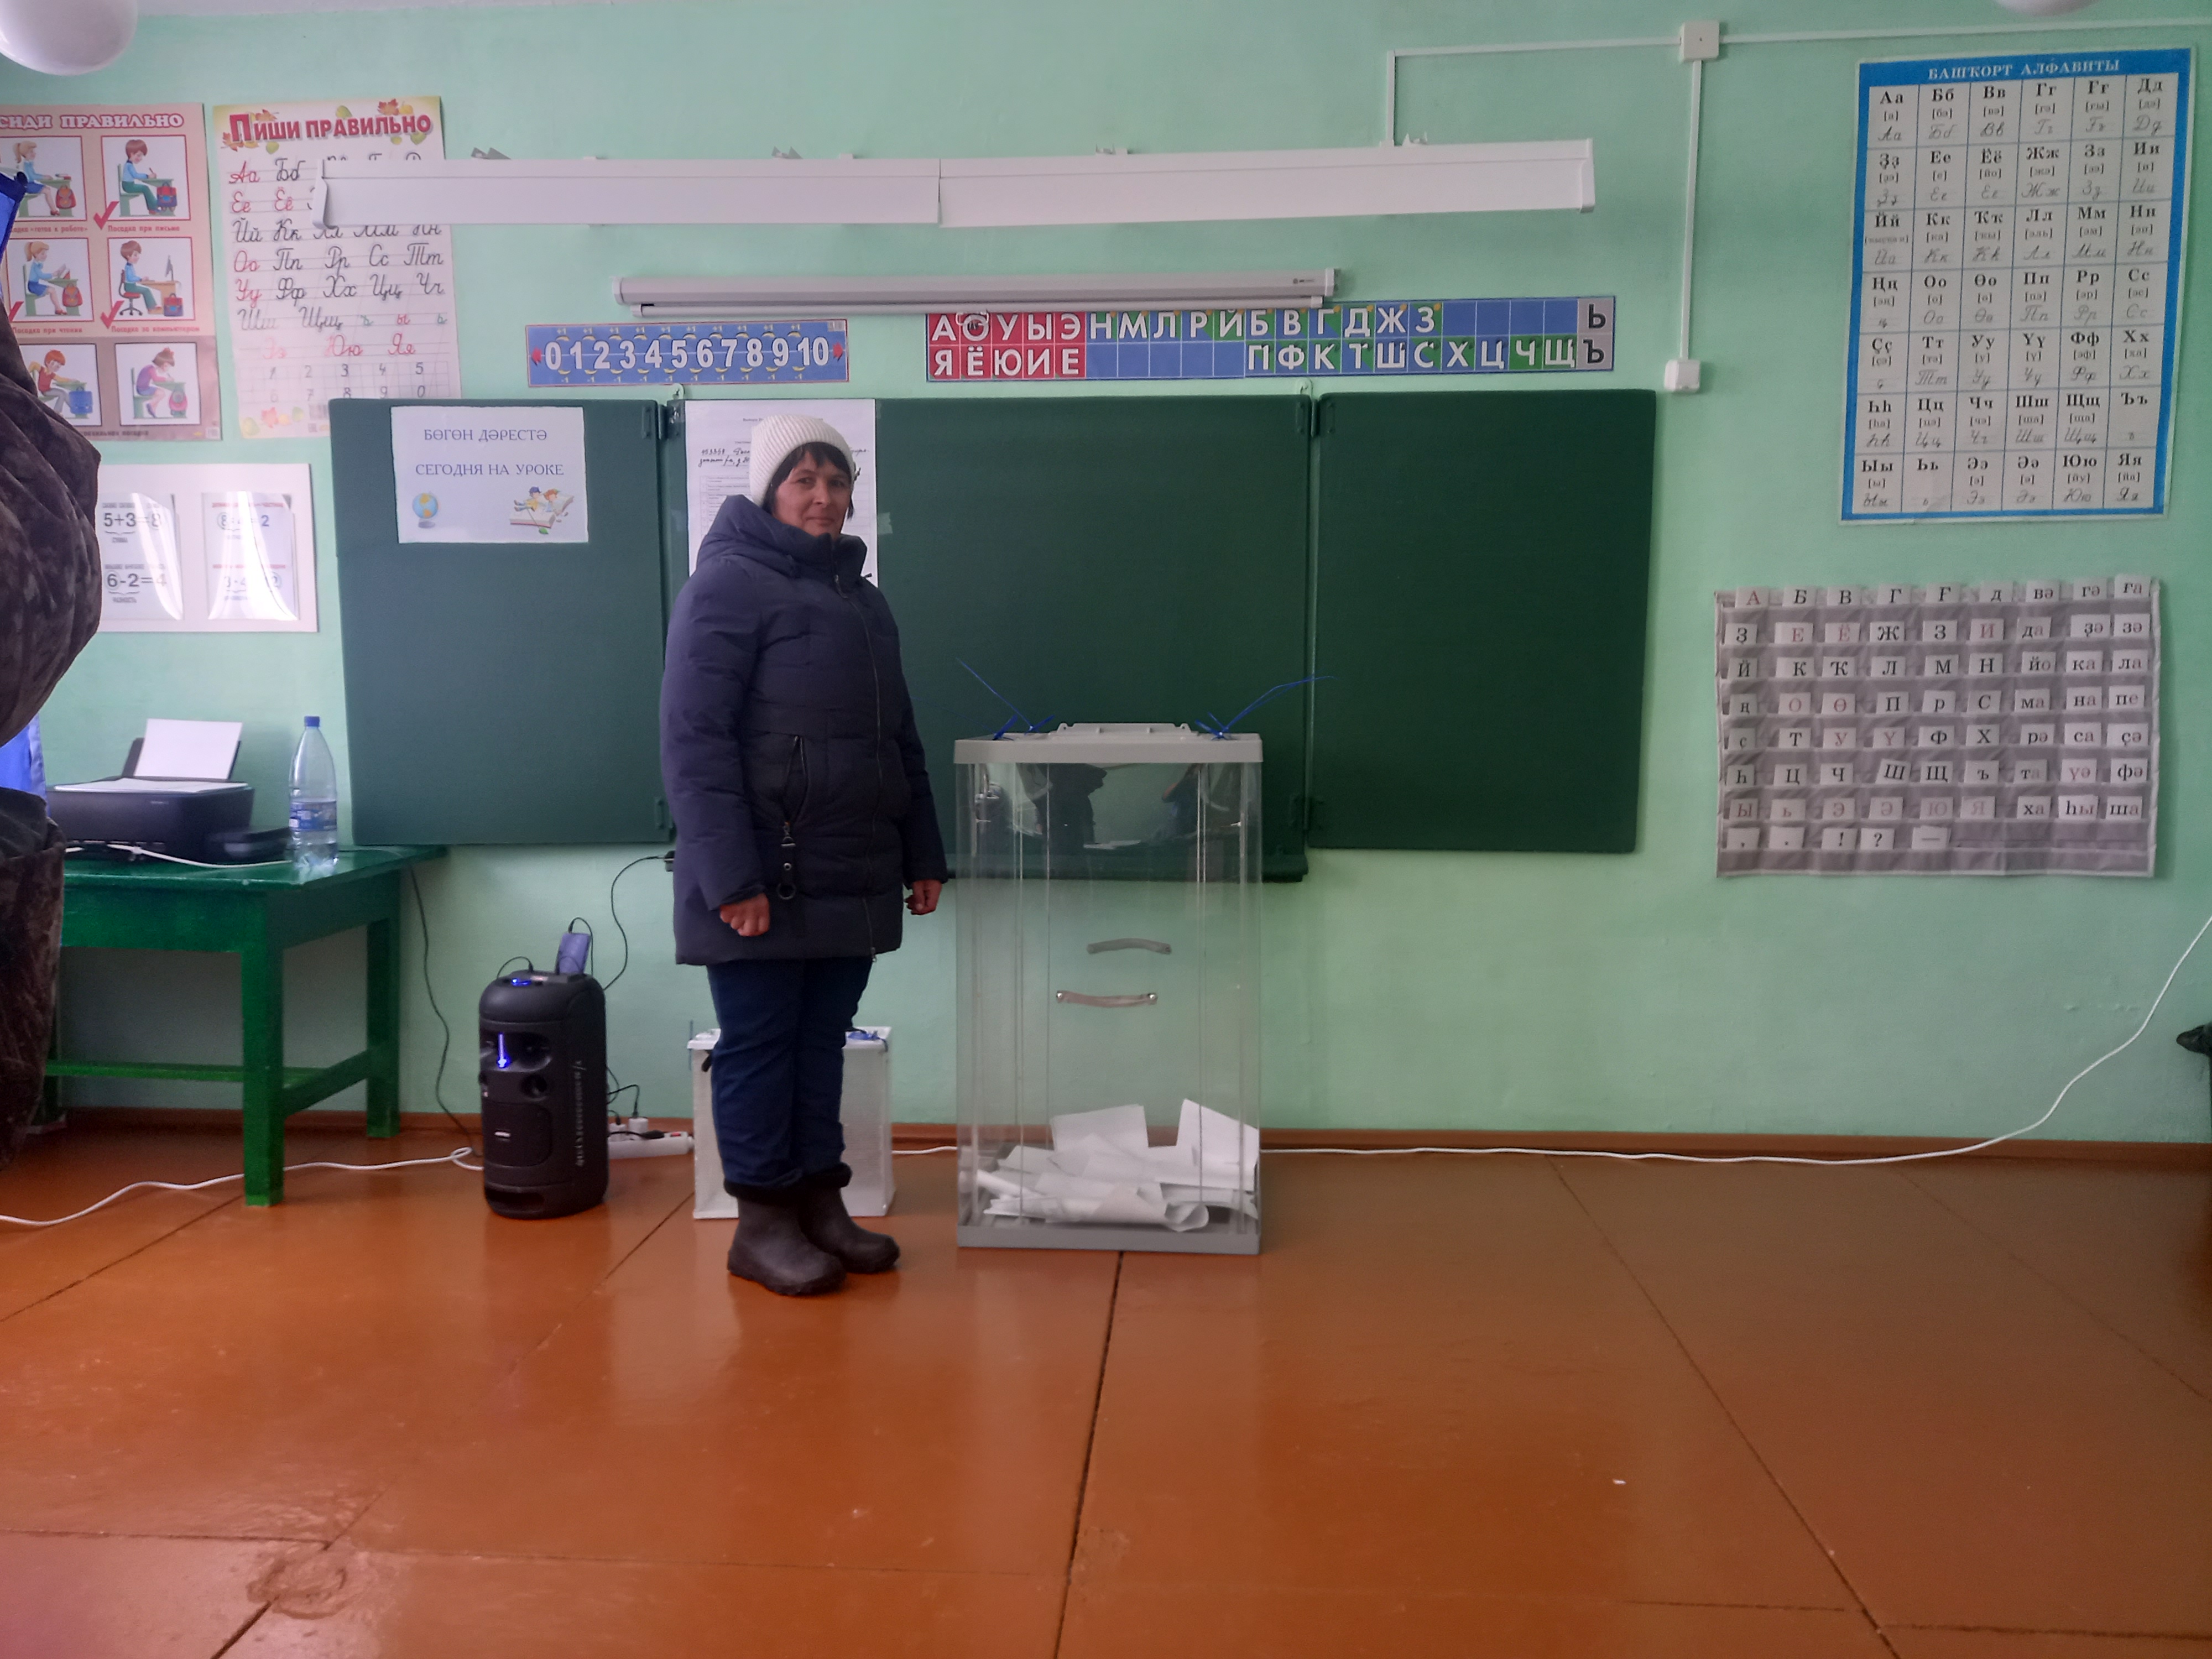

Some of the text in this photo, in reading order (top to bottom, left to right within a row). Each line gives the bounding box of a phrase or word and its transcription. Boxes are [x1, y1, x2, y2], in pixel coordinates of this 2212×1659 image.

[2021, 60, 2120, 75] АЛФАВИТЫ
[0, 113, 184, 130] СИДИ ПРАВИЛЬНО
[306, 115, 431, 138] ПРАВИЛЬНО
[932, 304, 1606, 341] А О У Ы Э Н М Л Р Й Б В Г Д Ж З Ь
[545, 337, 828, 369] 0 1 2 3 4 5 6 7 8 9 10
[934, 339, 1604, 375] Я Ё Ю И Е П Ф К Т Ш С Х Ц Ч Щ Ъ
[424, 430, 547, 442] БӨГӨН ДӘРЕСТӘ
[416, 465, 564, 477] СЕГОДНЯ НА УРОКЕ
